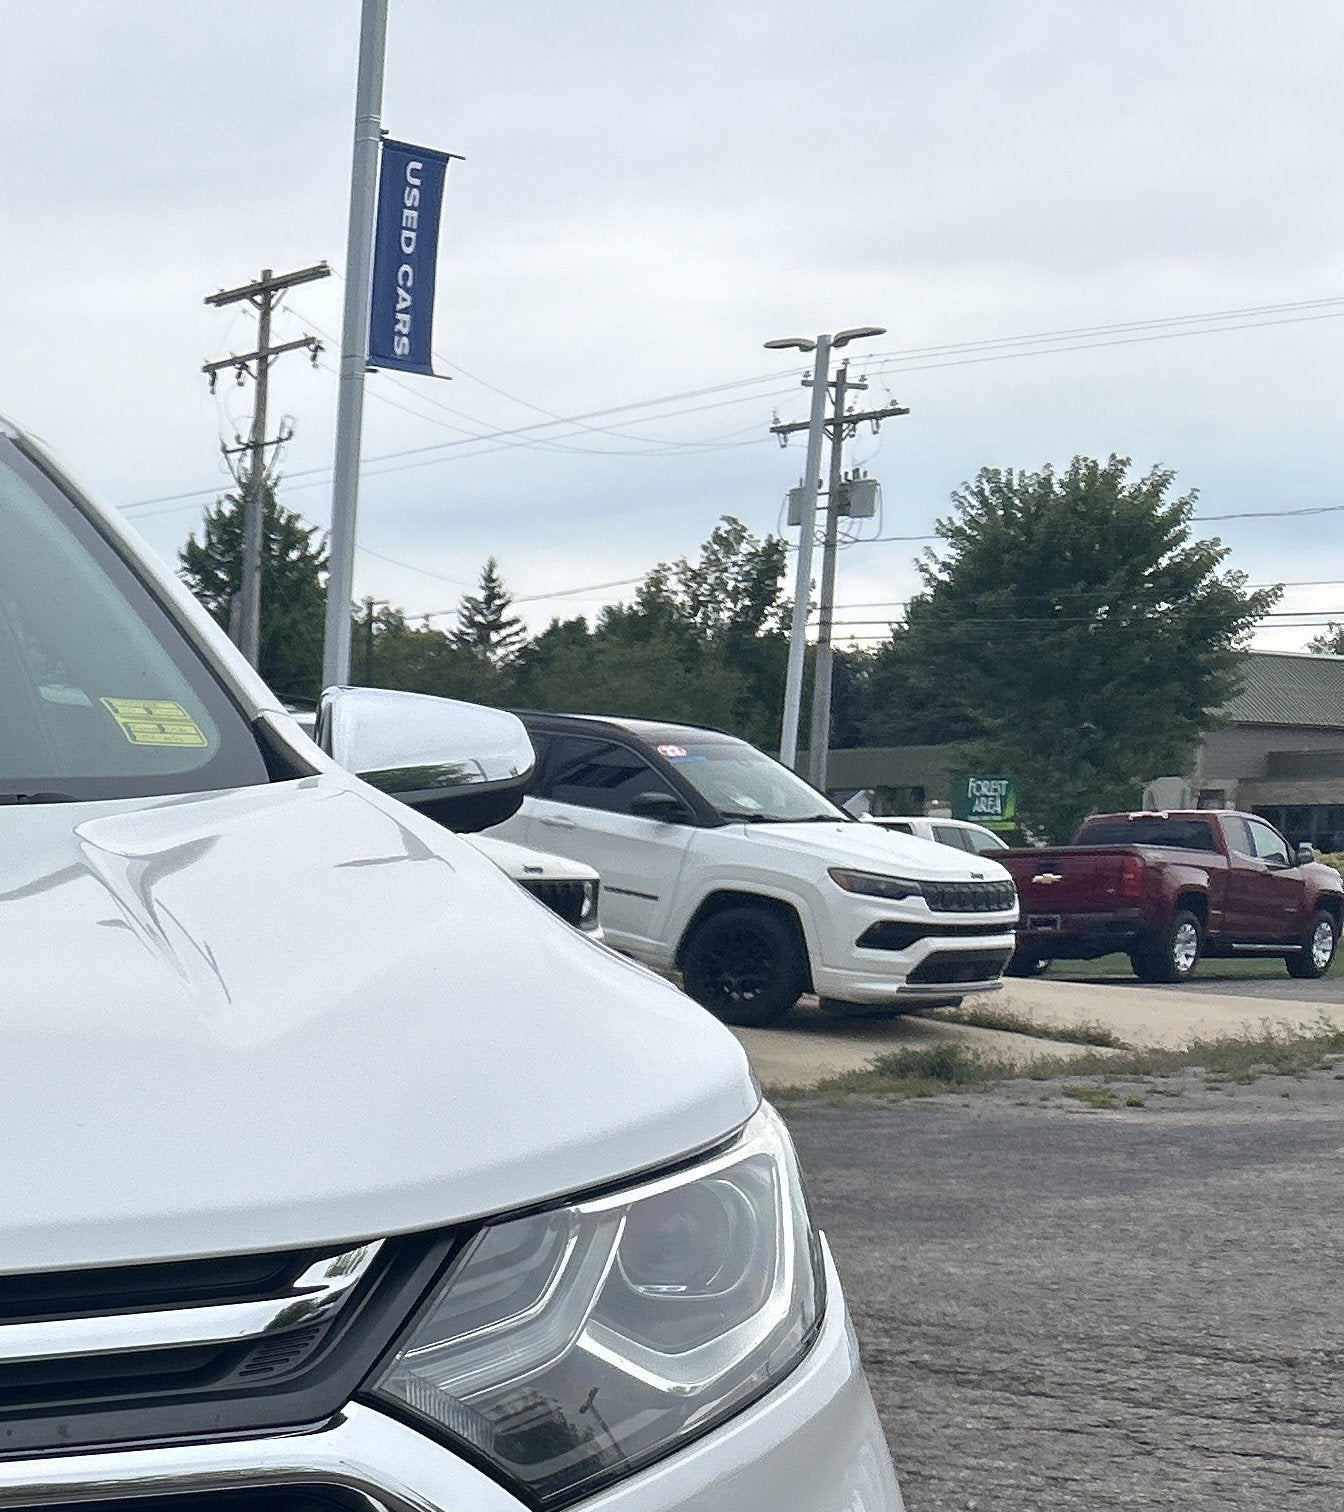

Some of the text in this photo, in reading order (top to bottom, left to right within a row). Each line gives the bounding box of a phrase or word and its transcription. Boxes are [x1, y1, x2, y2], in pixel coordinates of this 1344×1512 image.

[393, 161, 423, 358] USED CARS
[967, 777, 1009, 798] FOREST
[973, 796, 1002, 814] AREA
